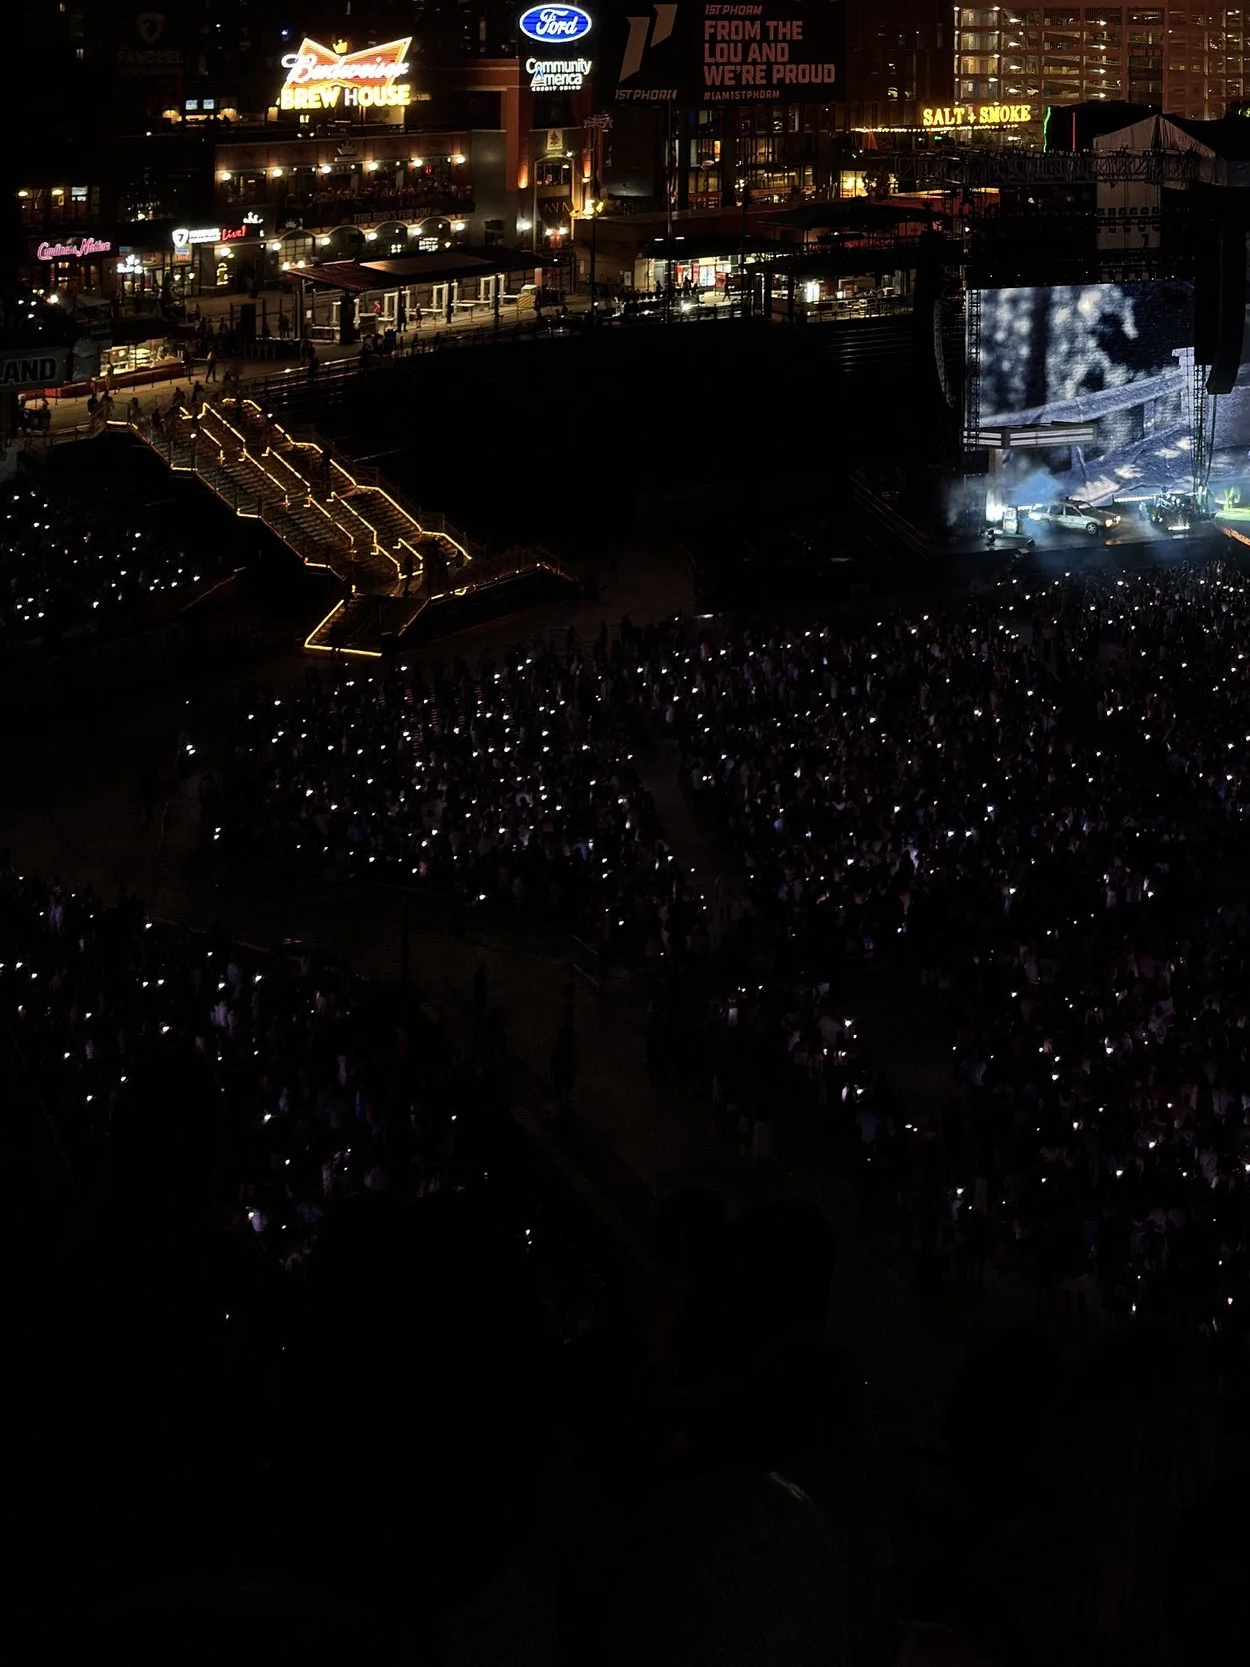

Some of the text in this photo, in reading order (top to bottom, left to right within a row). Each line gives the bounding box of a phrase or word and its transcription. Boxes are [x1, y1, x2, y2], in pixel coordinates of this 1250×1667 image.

[535, 9, 579, 35] Ford
[704, 20, 804, 41] FROM THE
[704, 42, 790, 63] LOU AND
[280, 53, 410, 84] Budweiser
[525, 57, 592, 76] Community
[772, 63, 836, 85] PROUD
[280, 84, 411, 110] BREW HOUSE
[923, 108, 965, 126] SALT
[979, 104, 1031, 124] SMOKE
[222, 225, 247, 241] Live!
[0, 356, 57, 386] AND
